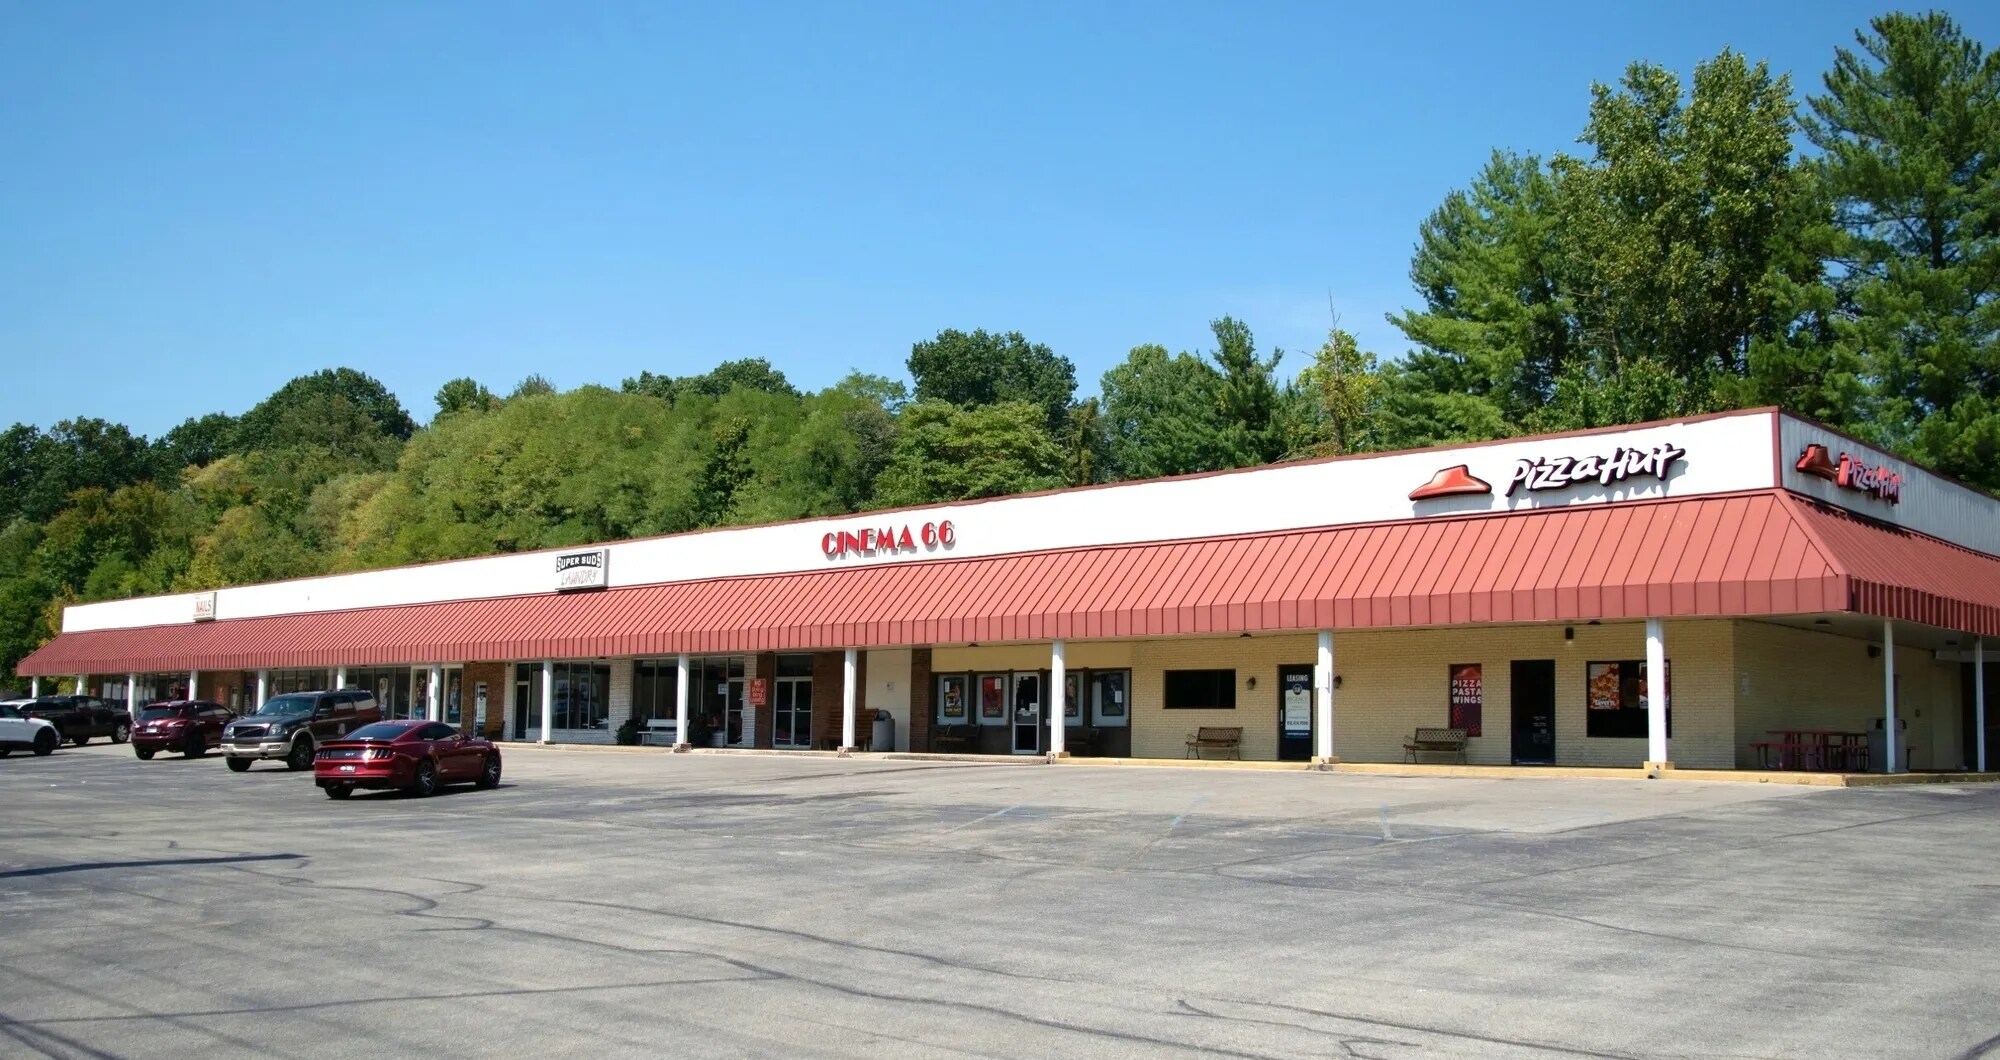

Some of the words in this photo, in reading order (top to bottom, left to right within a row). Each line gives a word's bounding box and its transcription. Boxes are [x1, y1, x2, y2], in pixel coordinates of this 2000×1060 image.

[1505, 455, 1600, 497] Pizza
[1598, 443, 1686, 486] Hut
[821, 524, 915, 555] CINEMA
[921, 520, 955, 546] 66
[556, 556, 580, 573] SUPER
[581, 552, 602, 568] SUDS
[196, 600, 212, 613] NAILS
[1286, 674, 1309, 682] LEASING
[1452, 688, 1482, 696] PASTA
[1452, 696, 1482, 704] WINGS
